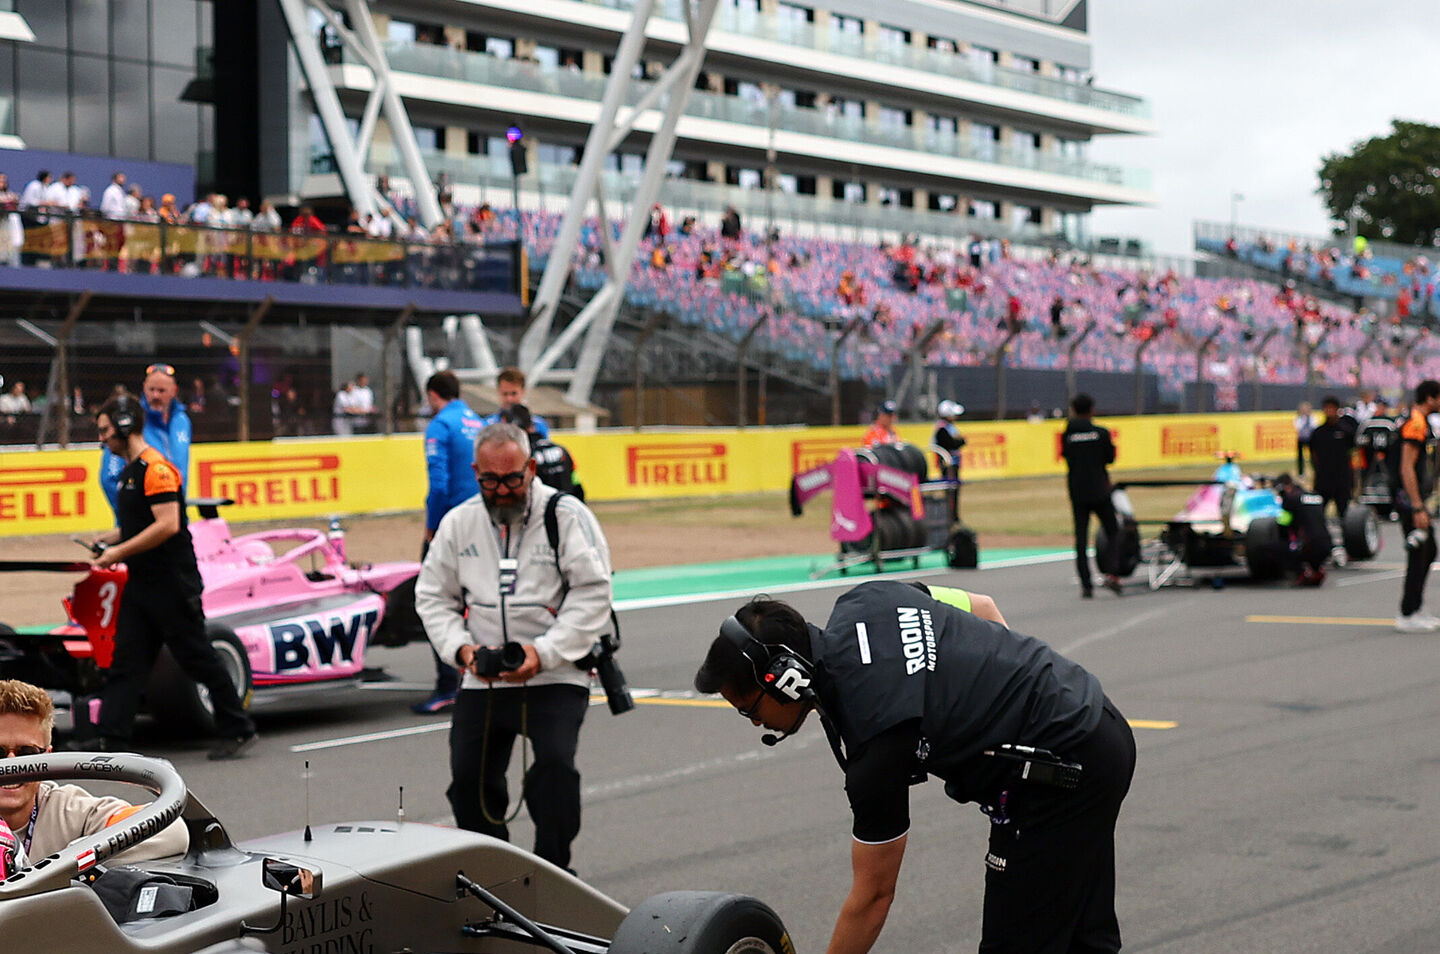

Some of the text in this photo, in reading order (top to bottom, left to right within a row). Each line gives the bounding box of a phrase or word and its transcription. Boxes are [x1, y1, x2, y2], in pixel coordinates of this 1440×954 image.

[197, 455, 340, 508] PIRELLI
[627, 443, 727, 484] PIRELLI
[98, 581, 118, 628] 3
[270, 609, 378, 670] BWT
[896, 607, 926, 675] RODIN
[920, 609, 937, 672] MOTORSPORT
[73, 762, 125, 773] ACADEMY
[281, 891, 374, 946] BAYLIS &
